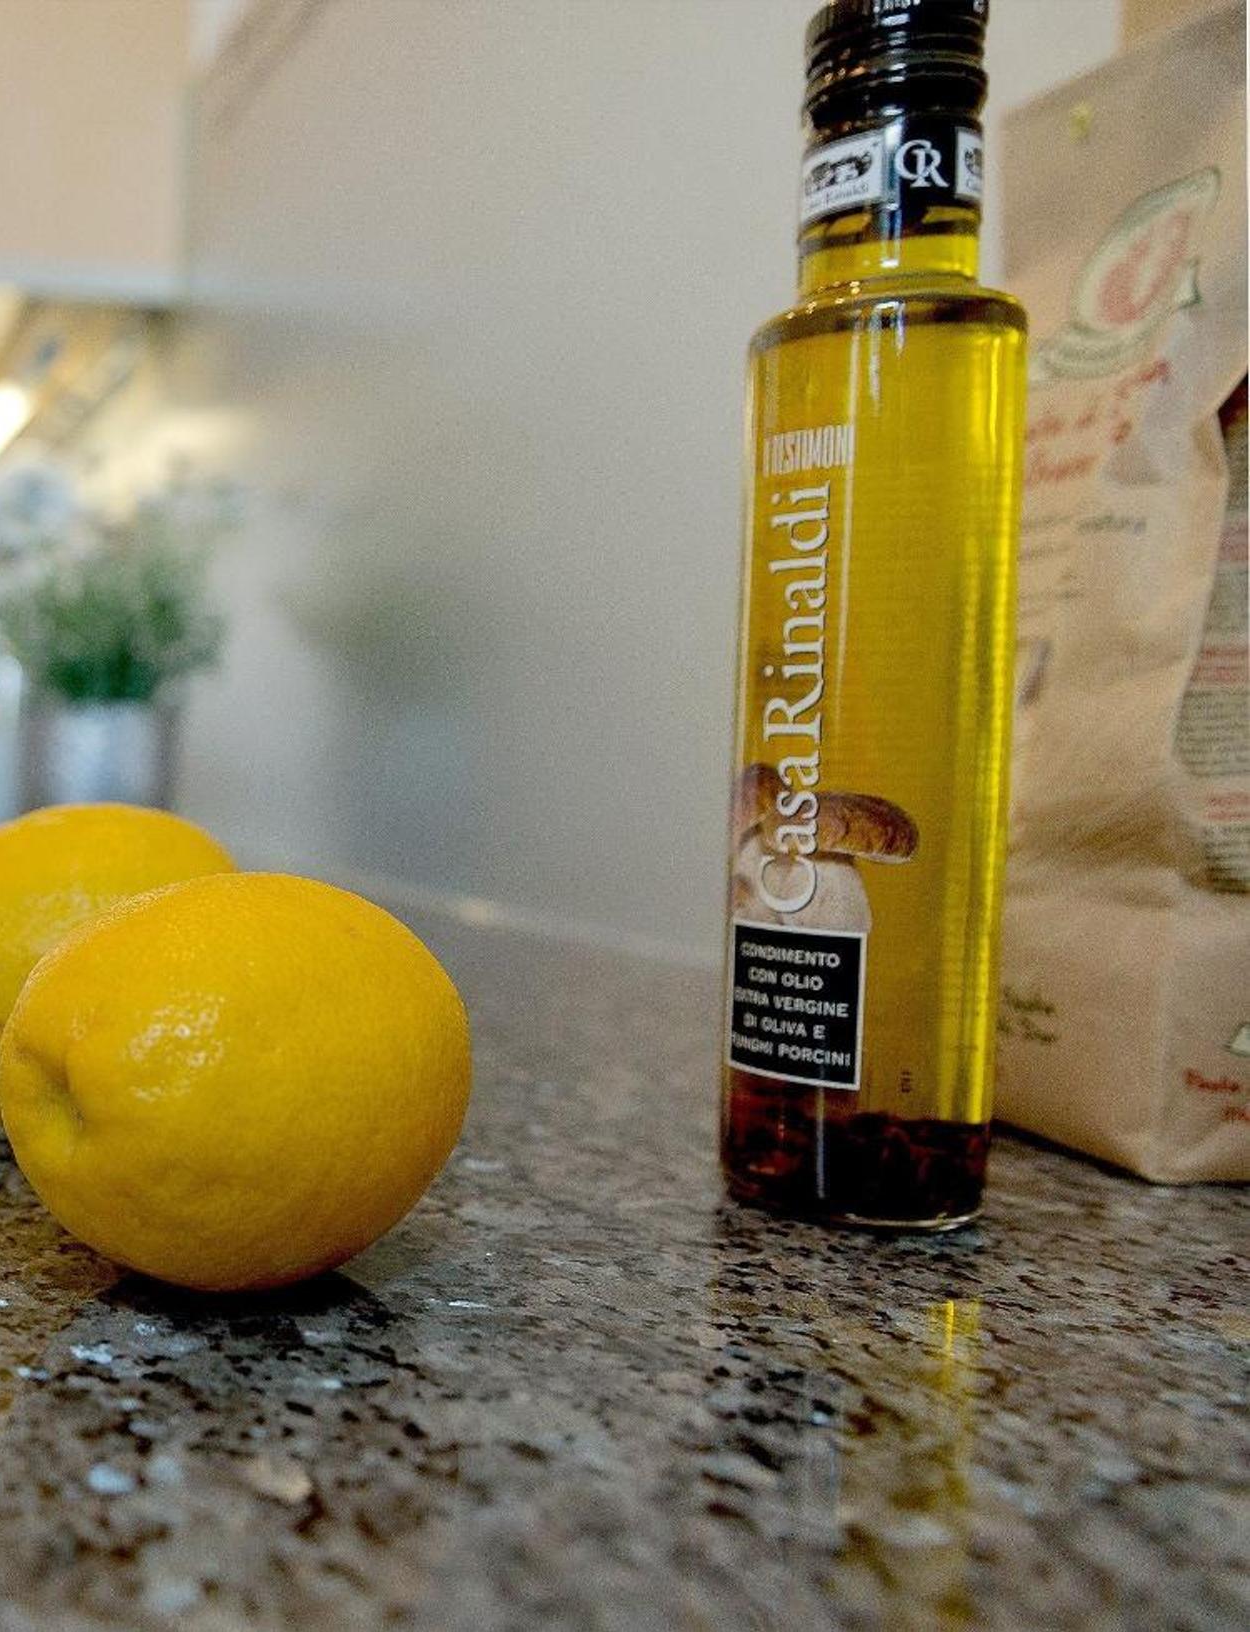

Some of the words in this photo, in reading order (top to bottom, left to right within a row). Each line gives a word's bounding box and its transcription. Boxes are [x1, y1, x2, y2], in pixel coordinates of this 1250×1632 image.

[740, 941, 841, 968] CONDIMENTO
[748, 966, 778, 985] CON
[781, 971, 824, 991] OLIO
[773, 995, 849, 1018] VERGINE
[760, 1016, 807, 1038] OLIVA
[813, 1024, 826, 1039] E
[778, 1042, 851, 1067] PORCINI
